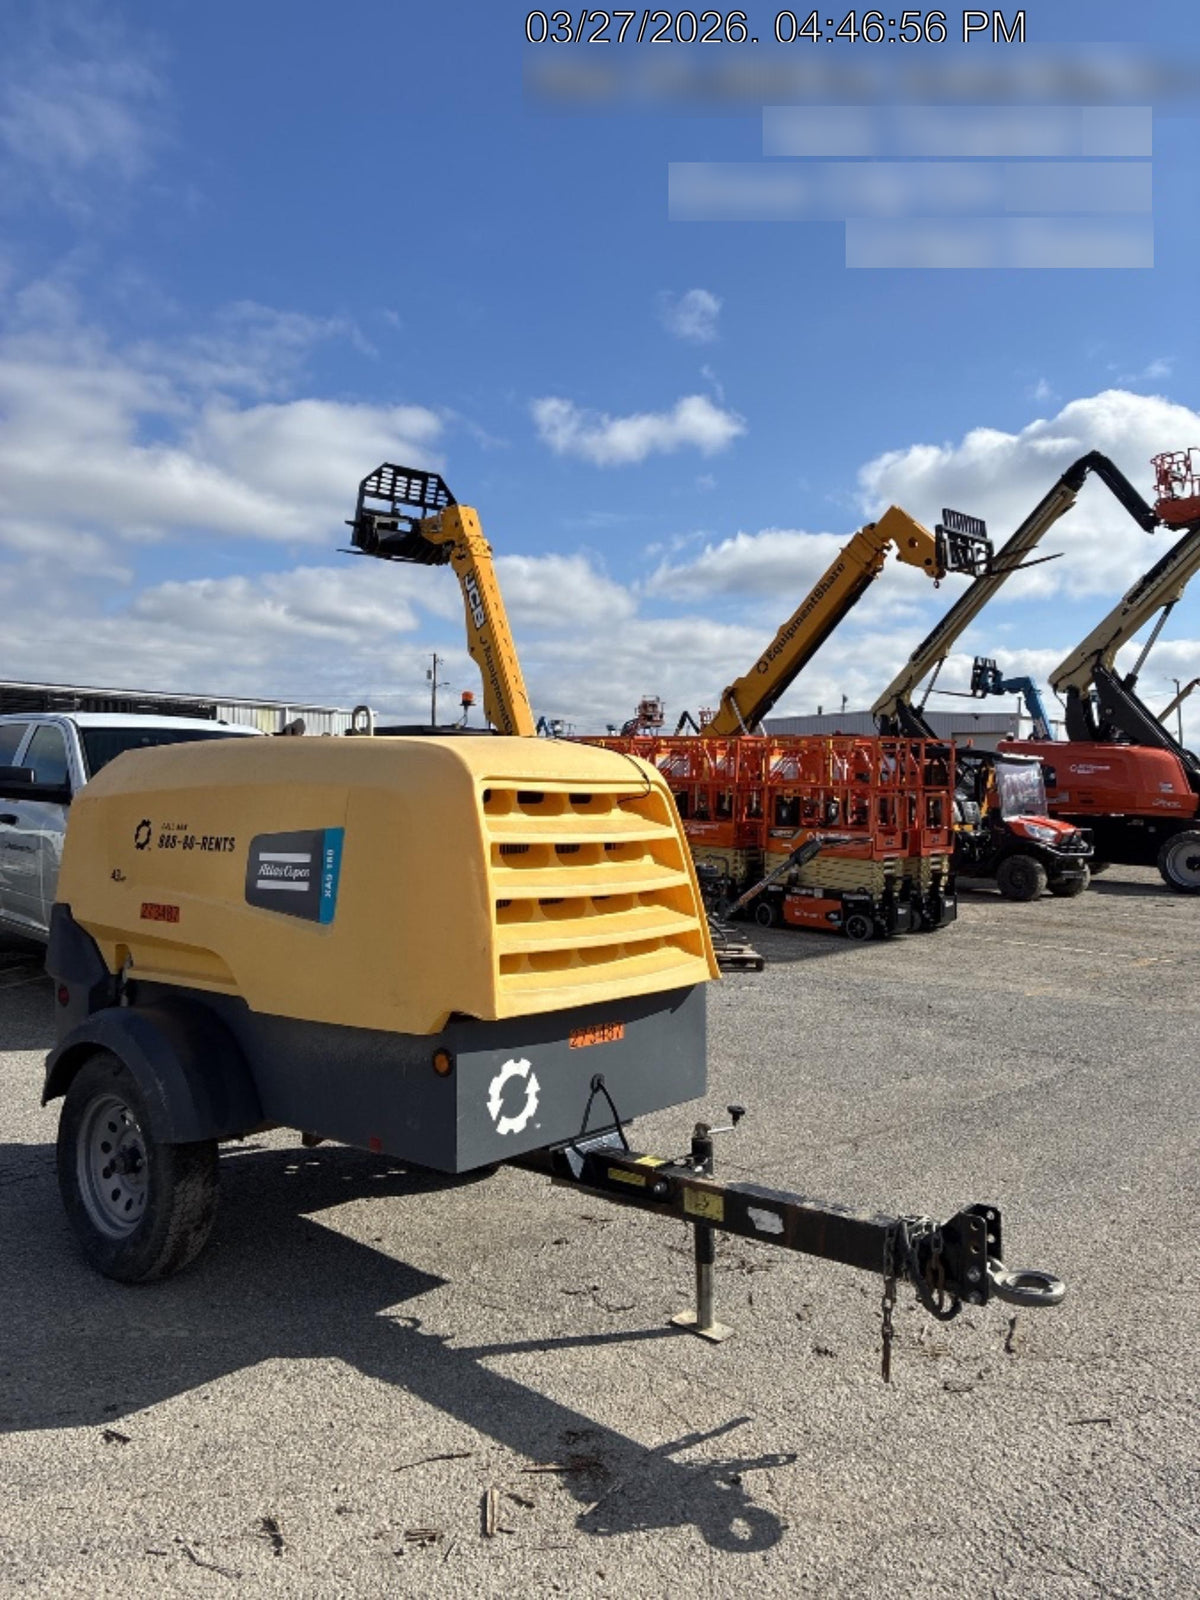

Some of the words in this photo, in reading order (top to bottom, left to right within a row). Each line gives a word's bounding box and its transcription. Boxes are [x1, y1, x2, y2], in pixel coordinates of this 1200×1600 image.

[463, 571, 487, 631] JCB
[766, 563, 845, 662] EquipmentShare
[157, 833, 236, 853] 888-88-RENTS
